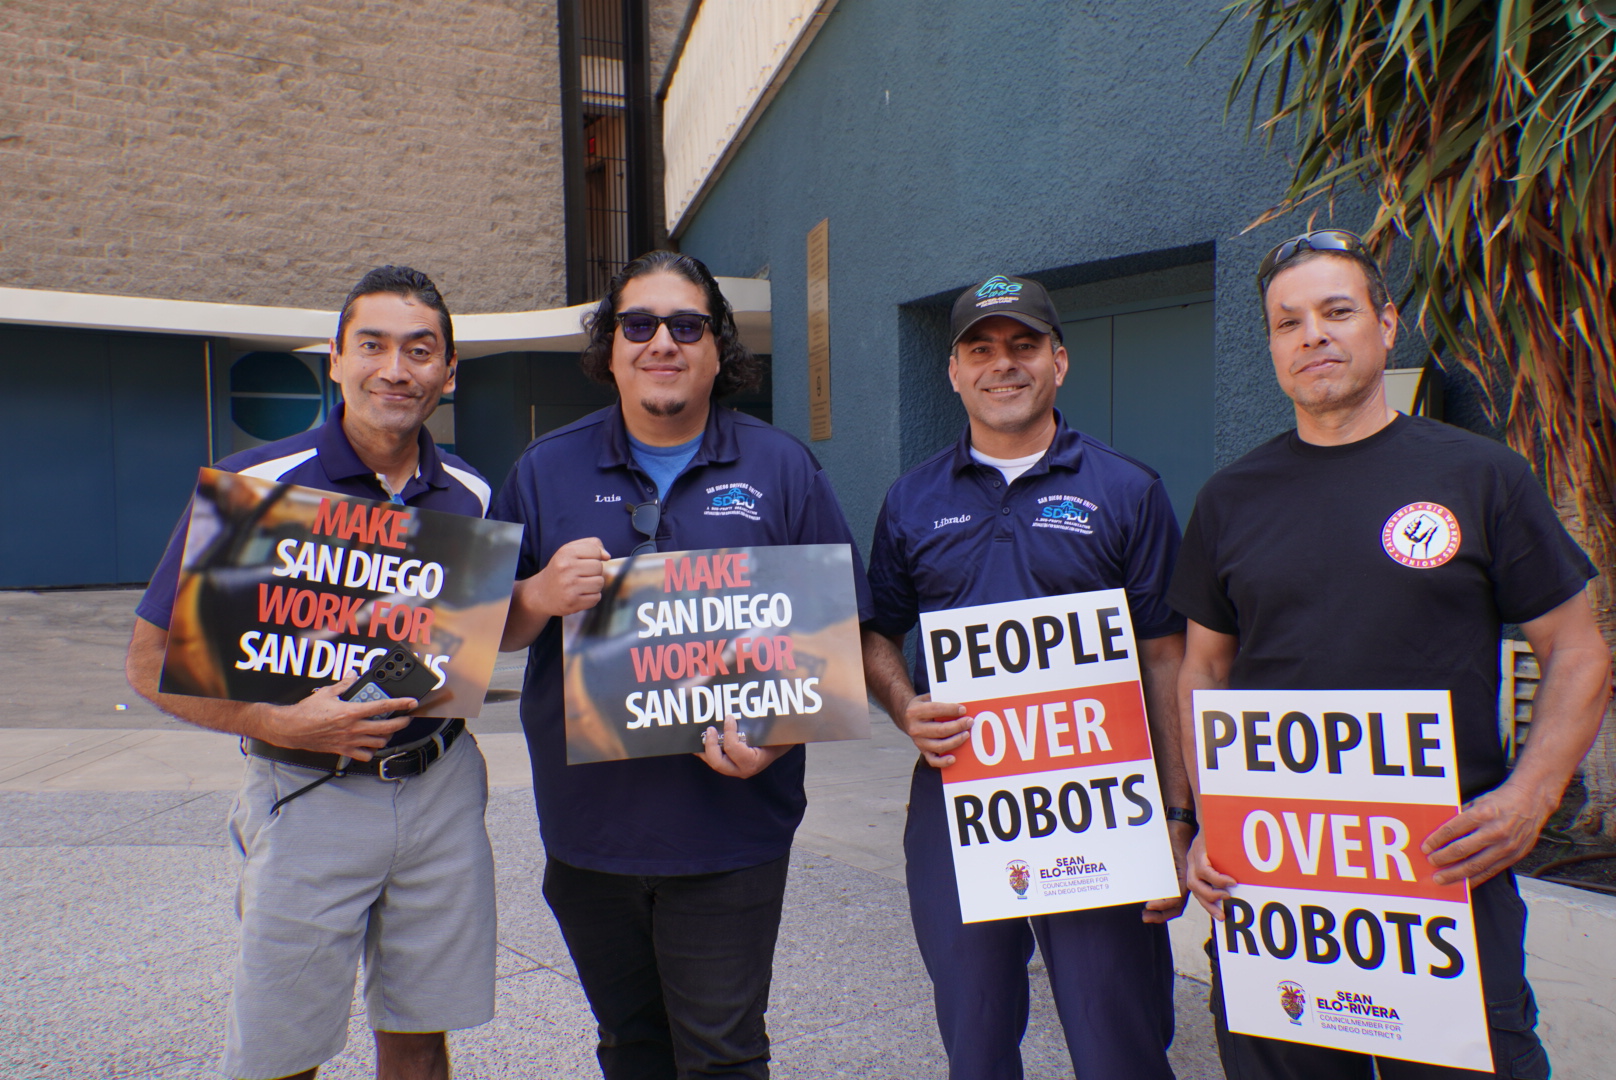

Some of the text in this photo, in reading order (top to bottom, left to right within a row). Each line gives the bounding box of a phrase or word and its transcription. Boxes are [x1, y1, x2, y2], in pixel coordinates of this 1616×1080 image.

[595, 493, 622, 503] Luis
[706, 486, 716, 494] SAN
[715, 483, 729, 492] DIEGO
[730, 482, 749, 490] DRIVERS
[1037, 496, 1048, 504] SAN
[1063, 495, 1084, 504] DRIVERS
[312, 497, 411, 549] MAKE
[933, 513, 971, 530] Librado
[1384, 504, 1458, 567] CALIFORNIA GIG WORKERS UNION
[272, 538, 444, 599] SAN DIEGO
[663, 553, 751, 593] MAKE
[258, 583, 435, 645] WORK FOR
[637, 592, 792, 638] SAN DIEGO
[235, 631, 309, 676] SAN
[630, 635, 796, 683] WORK FOR
[929, 606, 1129, 683] PEOPLE
[625, 677, 823, 730] SAN DIEGANS
[970, 698, 1113, 767] OVER
[1201, 710, 1446, 778] PEOPLE
[953, 773, 1153, 847] ROBOTS
[1055, 855, 1085, 867] SEAN
[1241, 809, 1417, 883] OVER
[1039, 862, 1107, 879] ELO-RIVERA
[1042, 876, 1109, 890] COUNCILMEMBER FOR
[1043, 889, 1057, 897] SAN
[1057, 887, 1076, 895] DIEGO
[1077, 884, 1104, 893] DISTRICT
[1222, 896, 1465, 980] ROBOTS
[1316, 997, 1401, 1021] ELO-RIVERA
[1336, 990, 1373, 1005] SEAN
[1319, 1014, 1402, 1032] COUNCILMEMBER FOR
[1321, 1022, 1337, 1031] SAN
[1338, 1025, 1361, 1034] DIEGO
[1361, 1029, 1395, 1039] DISTRICT
